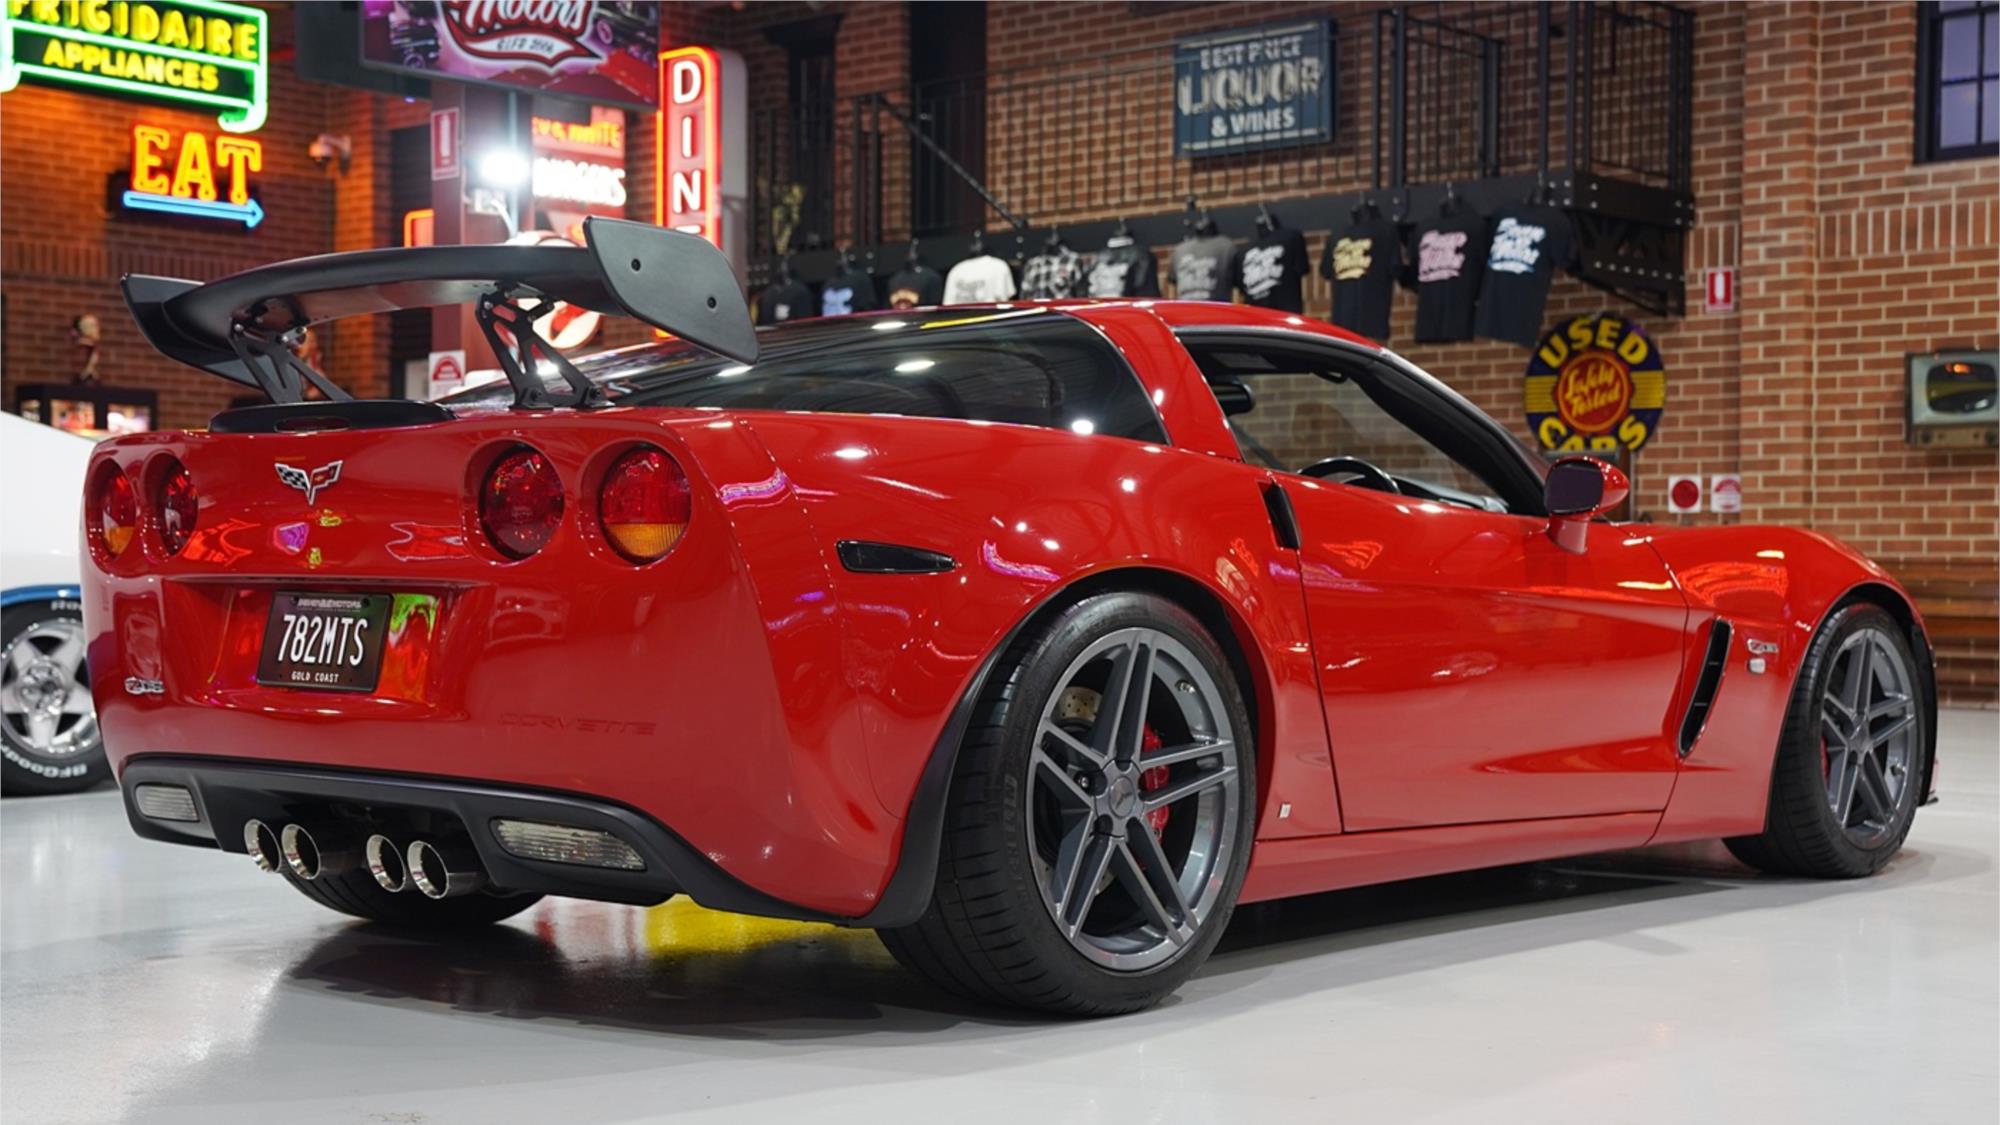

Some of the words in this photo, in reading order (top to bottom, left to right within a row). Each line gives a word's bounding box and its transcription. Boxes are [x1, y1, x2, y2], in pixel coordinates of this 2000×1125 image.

[43, 38, 219, 91] APPLIANCES
[672, 60, 702, 235] DIN
[1210, 115, 1228, 137] &
[1230, 107, 1296, 135] WINES
[132, 124, 262, 206] EAT
[1539, 318, 1649, 369] USED
[278, 614, 368, 666] 782MTS
[291, 671, 311, 682] GOLD
[314, 672, 339, 683] COAST
[500, 711, 657, 736] CORVETTE
